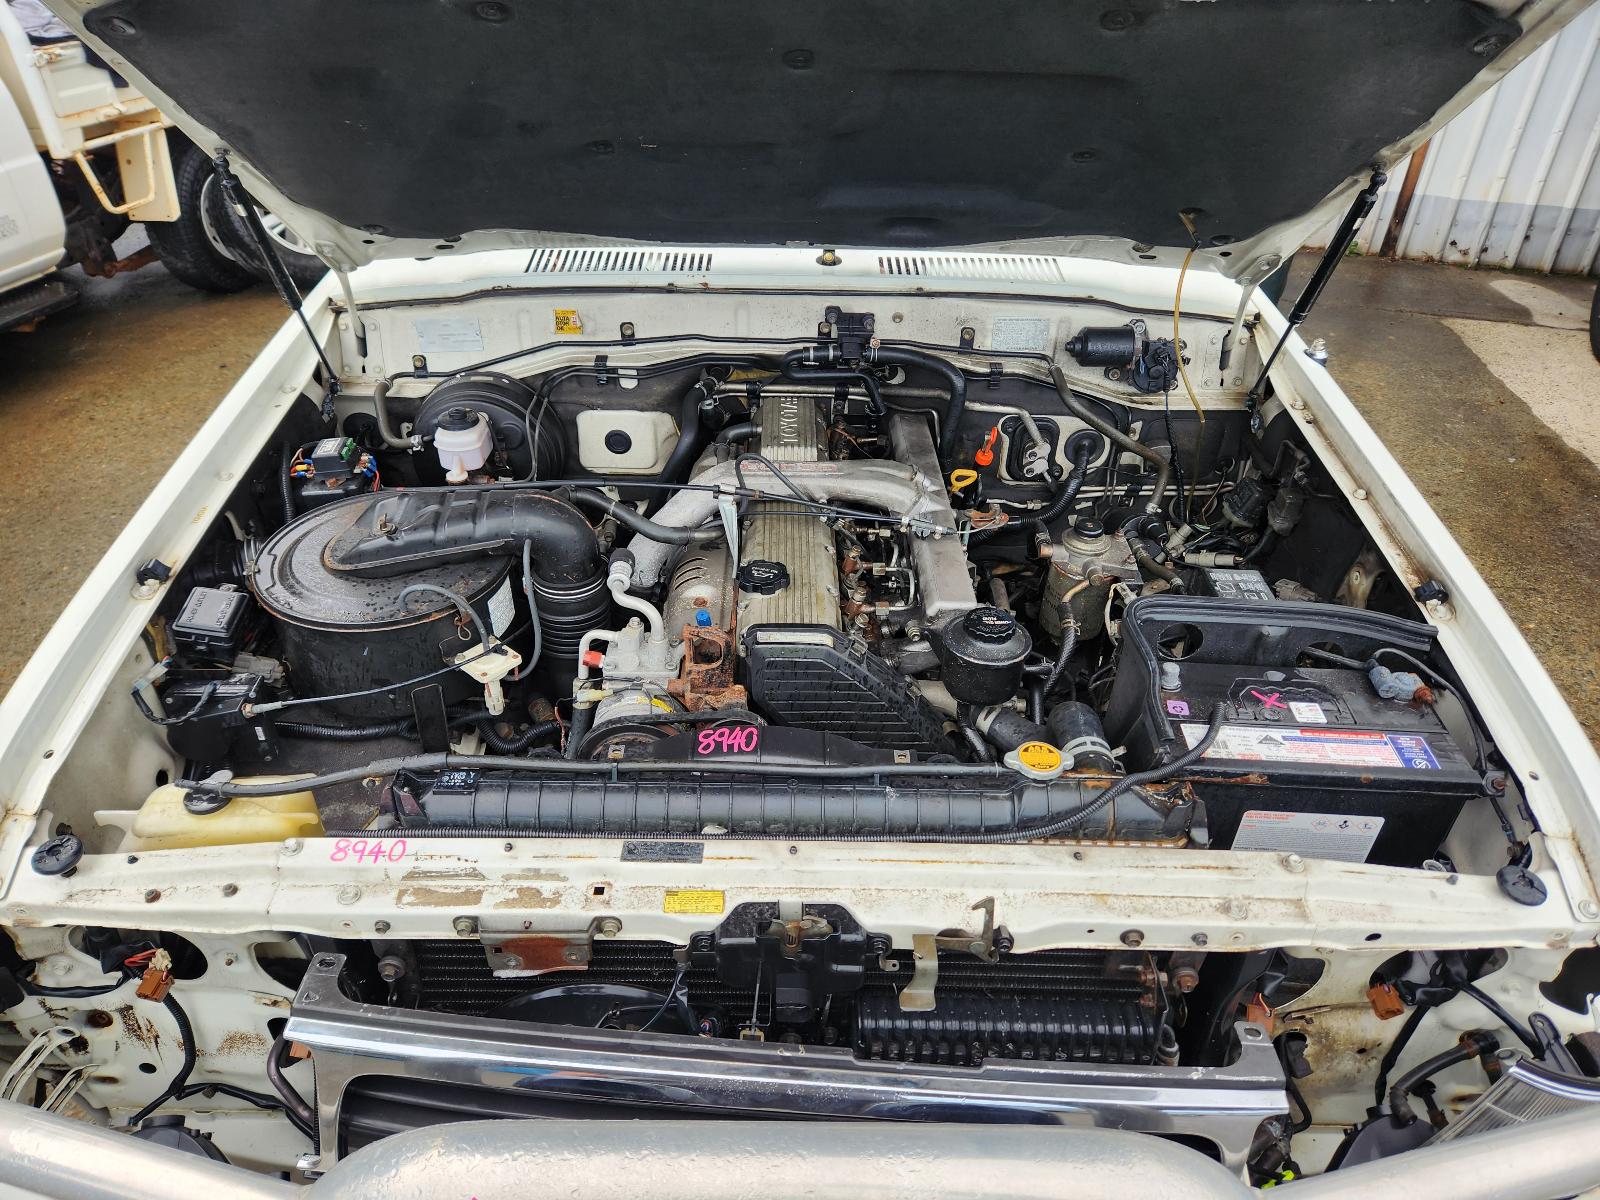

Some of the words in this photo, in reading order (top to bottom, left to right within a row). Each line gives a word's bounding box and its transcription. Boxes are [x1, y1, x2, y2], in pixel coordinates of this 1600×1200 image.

[780, 399, 798, 444] TOYOTA
[697, 726, 759, 755] 8940
[329, 838, 408, 865] 8940
